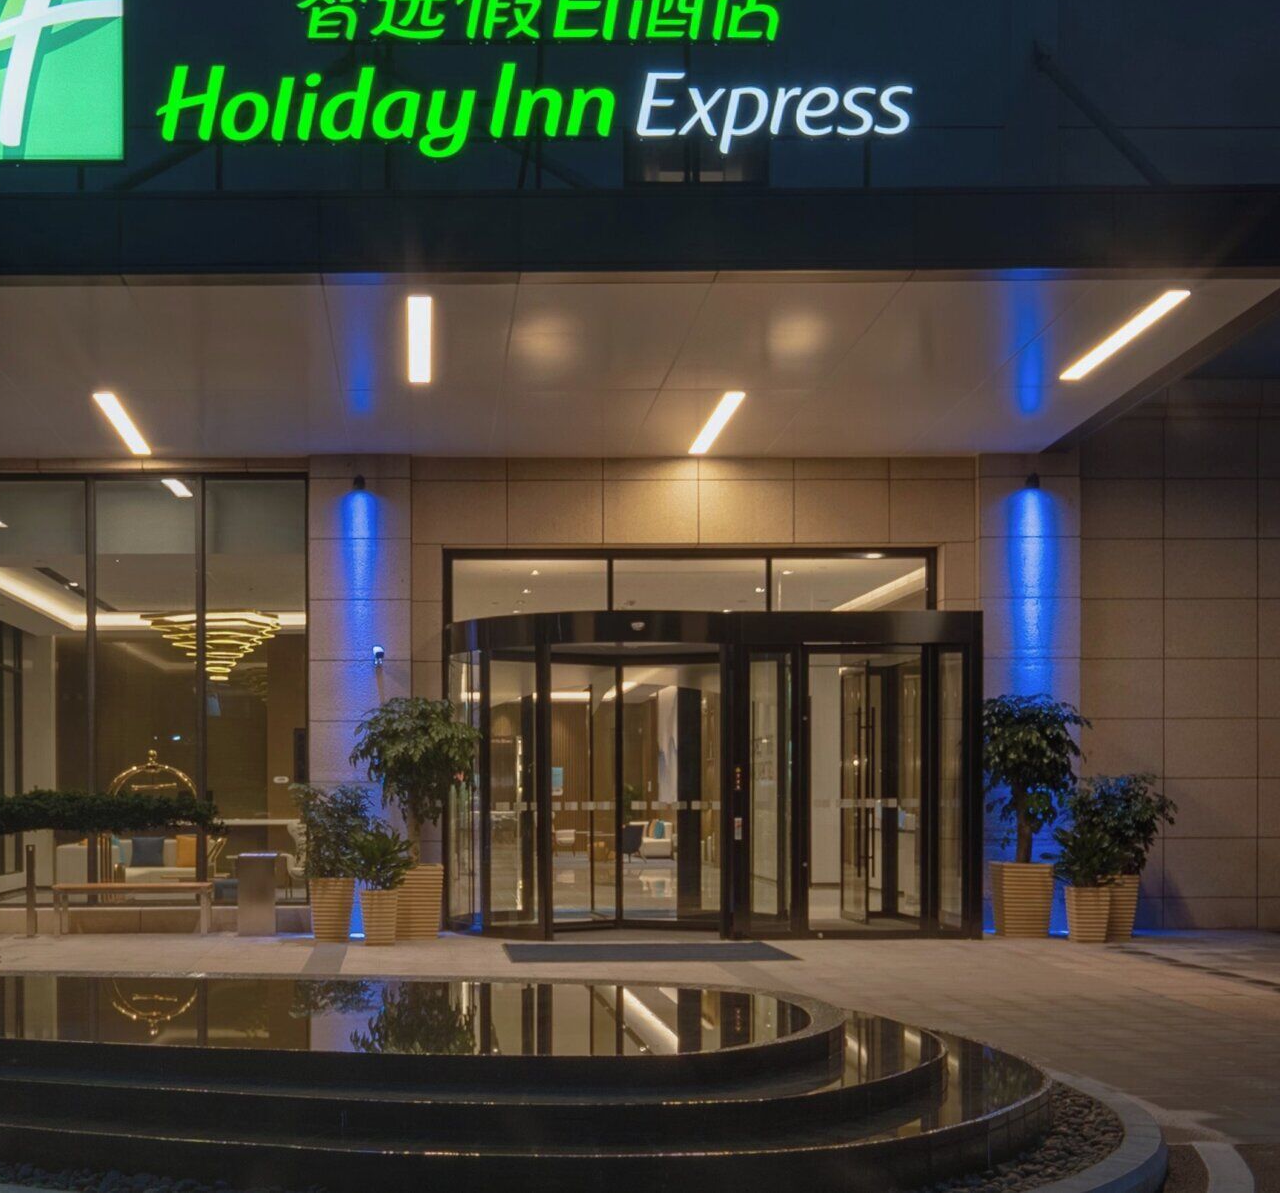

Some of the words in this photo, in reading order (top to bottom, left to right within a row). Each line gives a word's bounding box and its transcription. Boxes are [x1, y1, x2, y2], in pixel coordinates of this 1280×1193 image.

[154, 63, 477, 159] Holiday
[489, 61, 617, 140] Inn
[635, 71, 914, 156] Express
